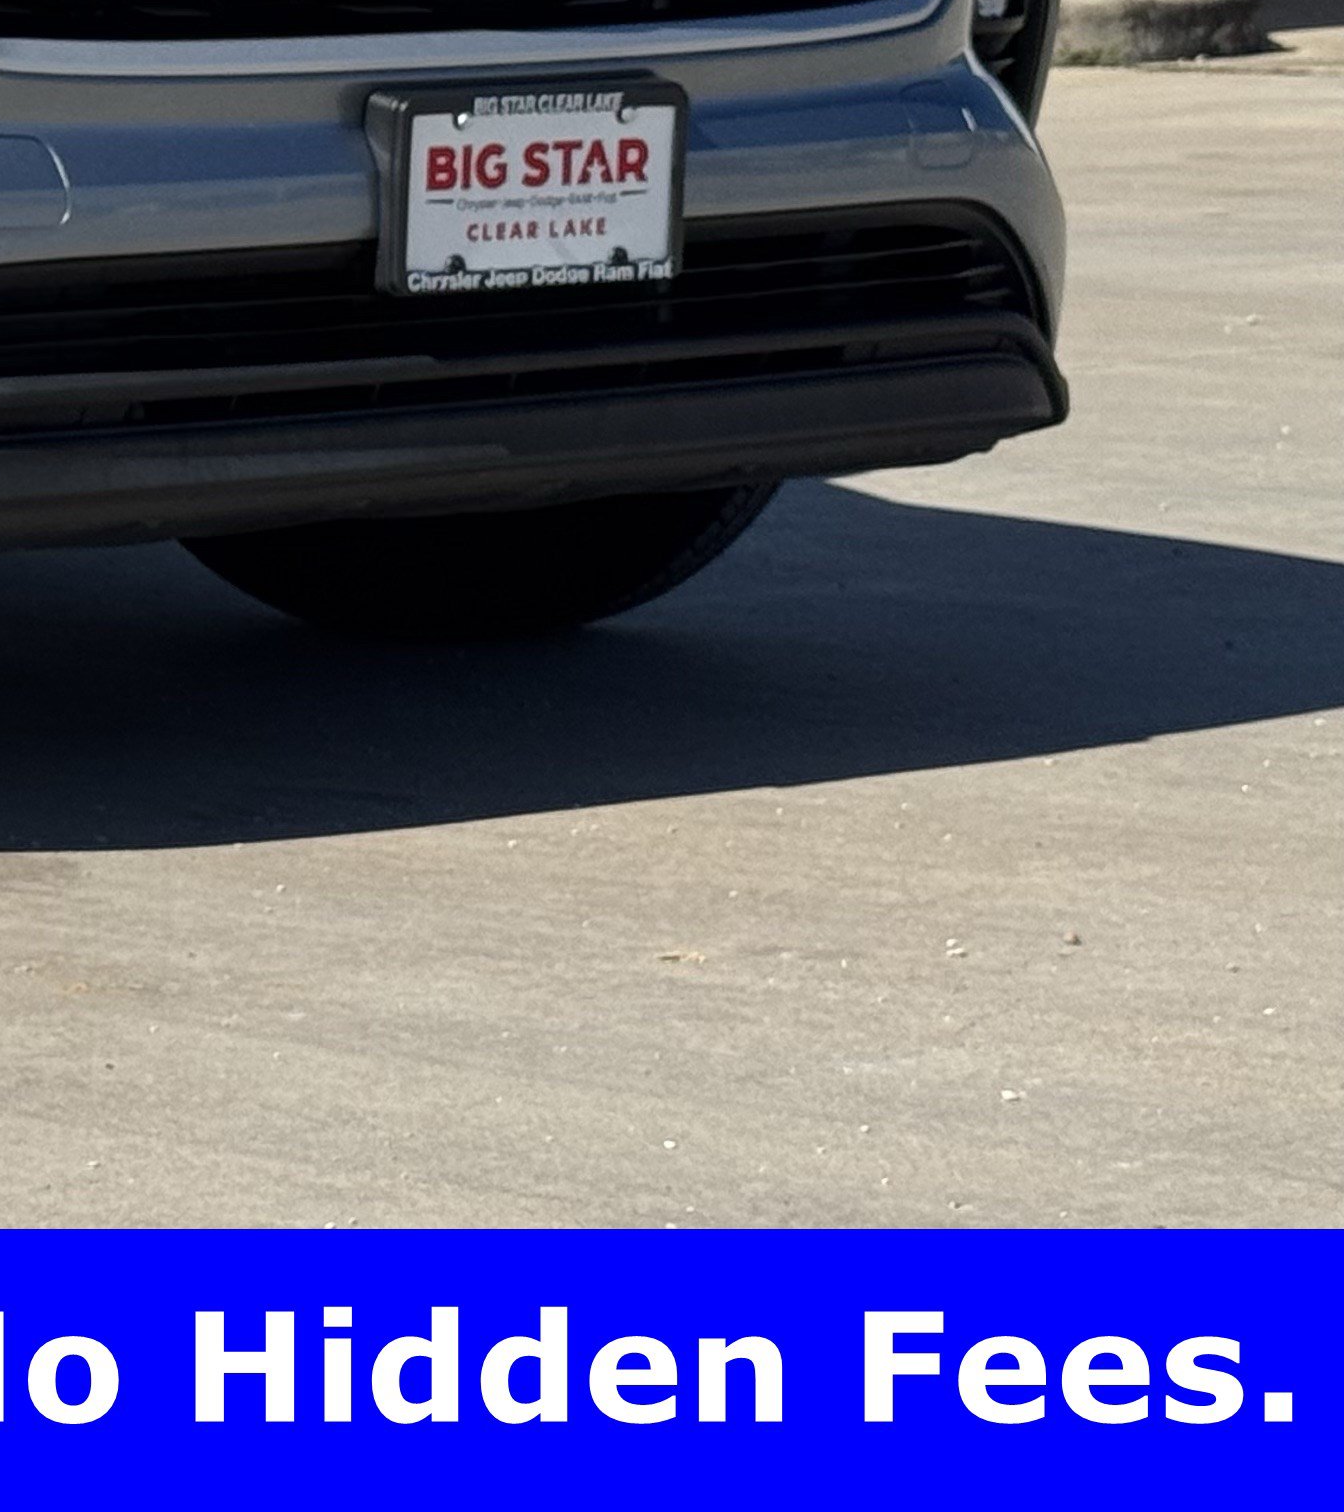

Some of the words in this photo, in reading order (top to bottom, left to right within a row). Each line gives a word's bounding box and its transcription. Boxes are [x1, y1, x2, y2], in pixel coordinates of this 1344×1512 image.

[474, 96, 499, 115] BIG
[501, 95, 537, 114] STAR
[538, 93, 584, 113] CLEAR
[586, 91, 624, 112] LAKE
[425, 143, 508, 192] BIG
[522, 138, 648, 187] STAR
[466, 220, 538, 242] CLEAR
[549, 217, 607, 238] LAKE
[407, 271, 483, 292] Chrysler
[484, 270, 529, 288] Jeep
[532, 267, 590, 285] Dodge
[593, 263, 635, 282] Ram
[638, 259, 672, 281] Fiat
